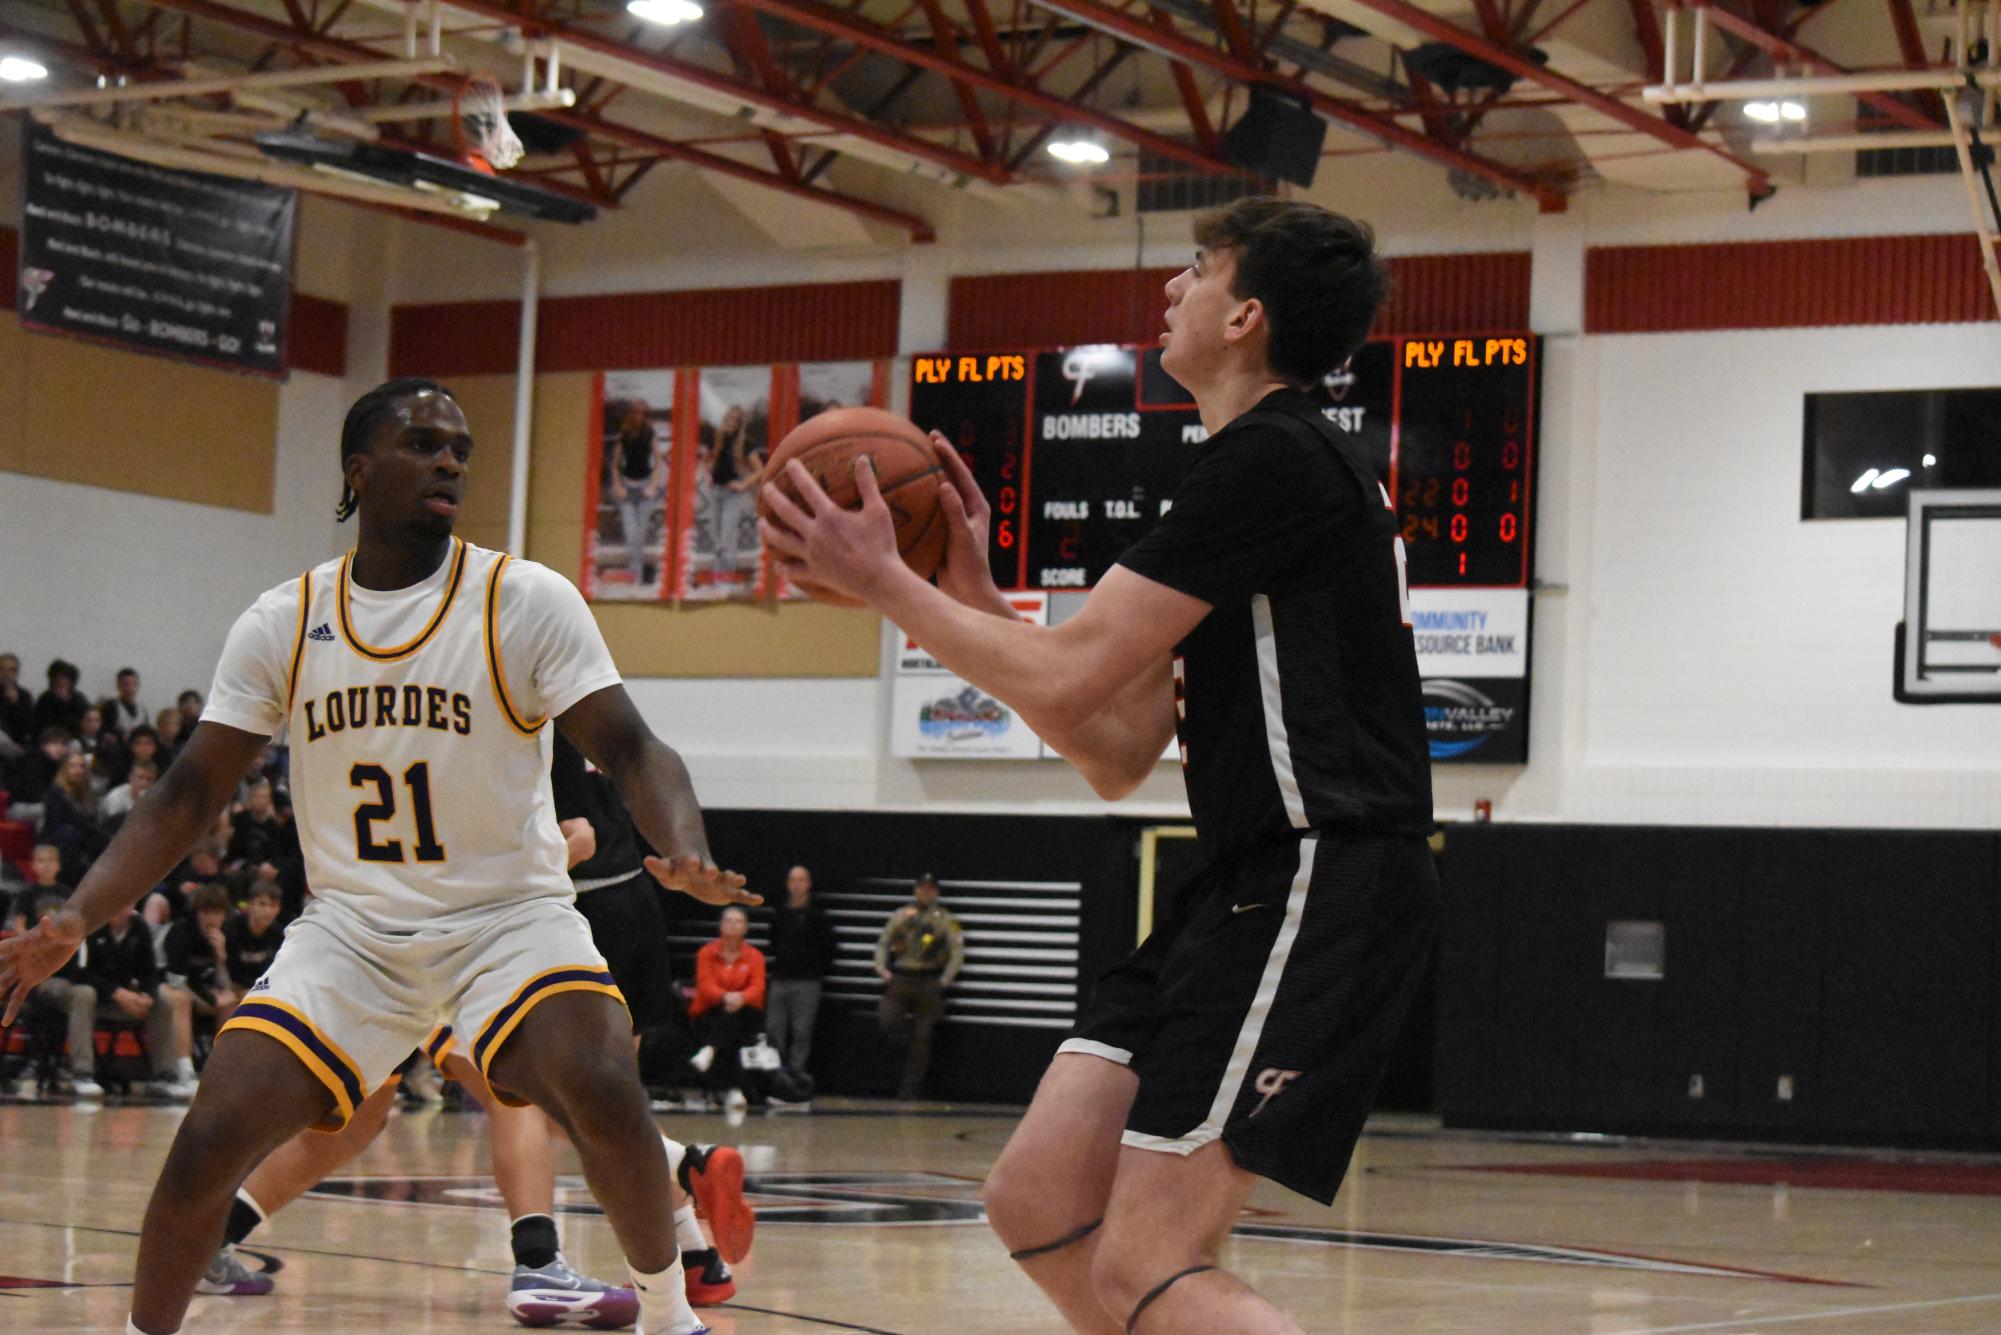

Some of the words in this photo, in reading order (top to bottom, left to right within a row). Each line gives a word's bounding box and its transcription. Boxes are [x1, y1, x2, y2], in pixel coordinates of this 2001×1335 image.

[1405, 341, 1444, 367] PLY
[1454, 340, 1480, 366] FL
[1485, 339, 1527, 366] PTS
[915, 358, 951, 384] PLY
[959, 357, 982, 382] FL
[986, 355, 1024, 381] PTS
[1042, 413, 1141, 440] BOMBERS
[1321, 407, 1365, 433] EST
[1000, 486, 1016, 514] 0
[1452, 477, 1468, 507] 0
[1044, 500, 1089, 519] FOULS
[998, 521, 1014, 548] 6
[1404, 514, 1439, 543] 24
[1451, 513, 1467, 543] 0
[1499, 512, 1516, 542] 0
[1040, 568, 1086, 587] SCORE
[1458, 552, 1467, 577] 1
[1411, 611, 1488, 631] OMMUNITY
[308, 632, 335, 641] adidas
[304, 685, 471, 742] LOURDES
[350, 760, 446, 864] 21
